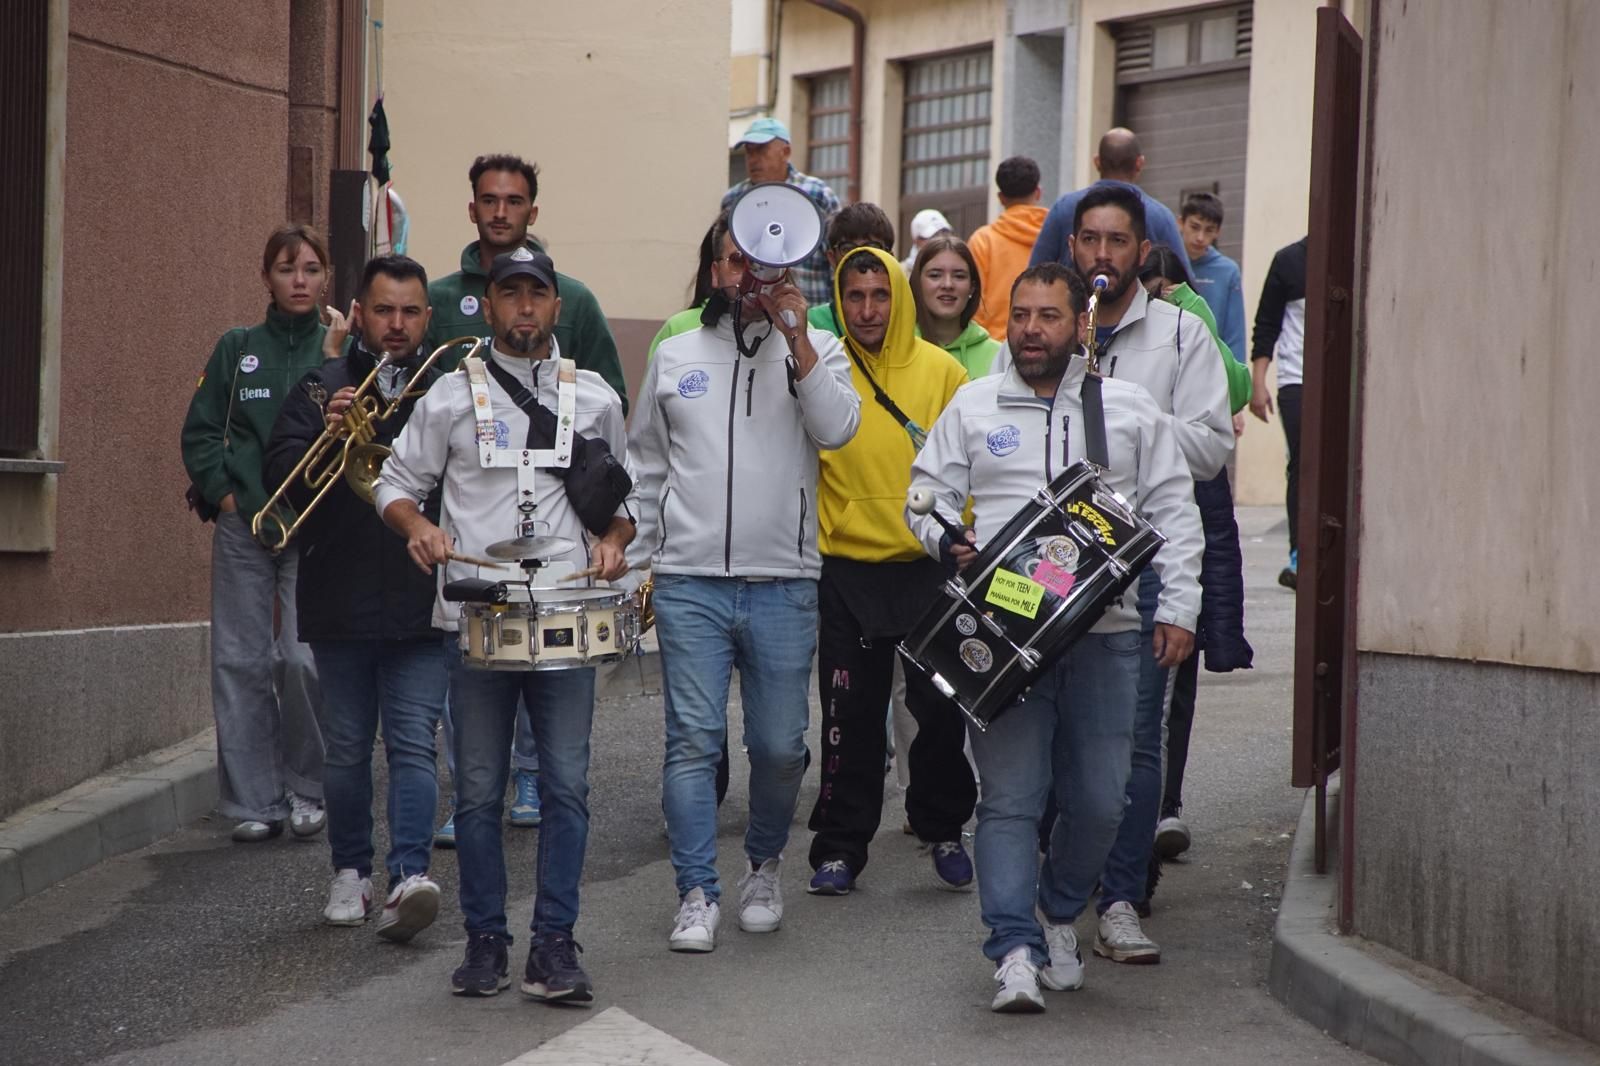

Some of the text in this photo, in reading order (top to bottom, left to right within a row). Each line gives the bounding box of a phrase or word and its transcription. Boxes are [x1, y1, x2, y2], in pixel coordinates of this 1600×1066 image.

[240, 387, 270, 401] Elena
[995, 576, 1031, 594] HOY POR TEEN
[1011, 598, 1020, 607] POR
[1020, 599, 1036, 613] MILF
